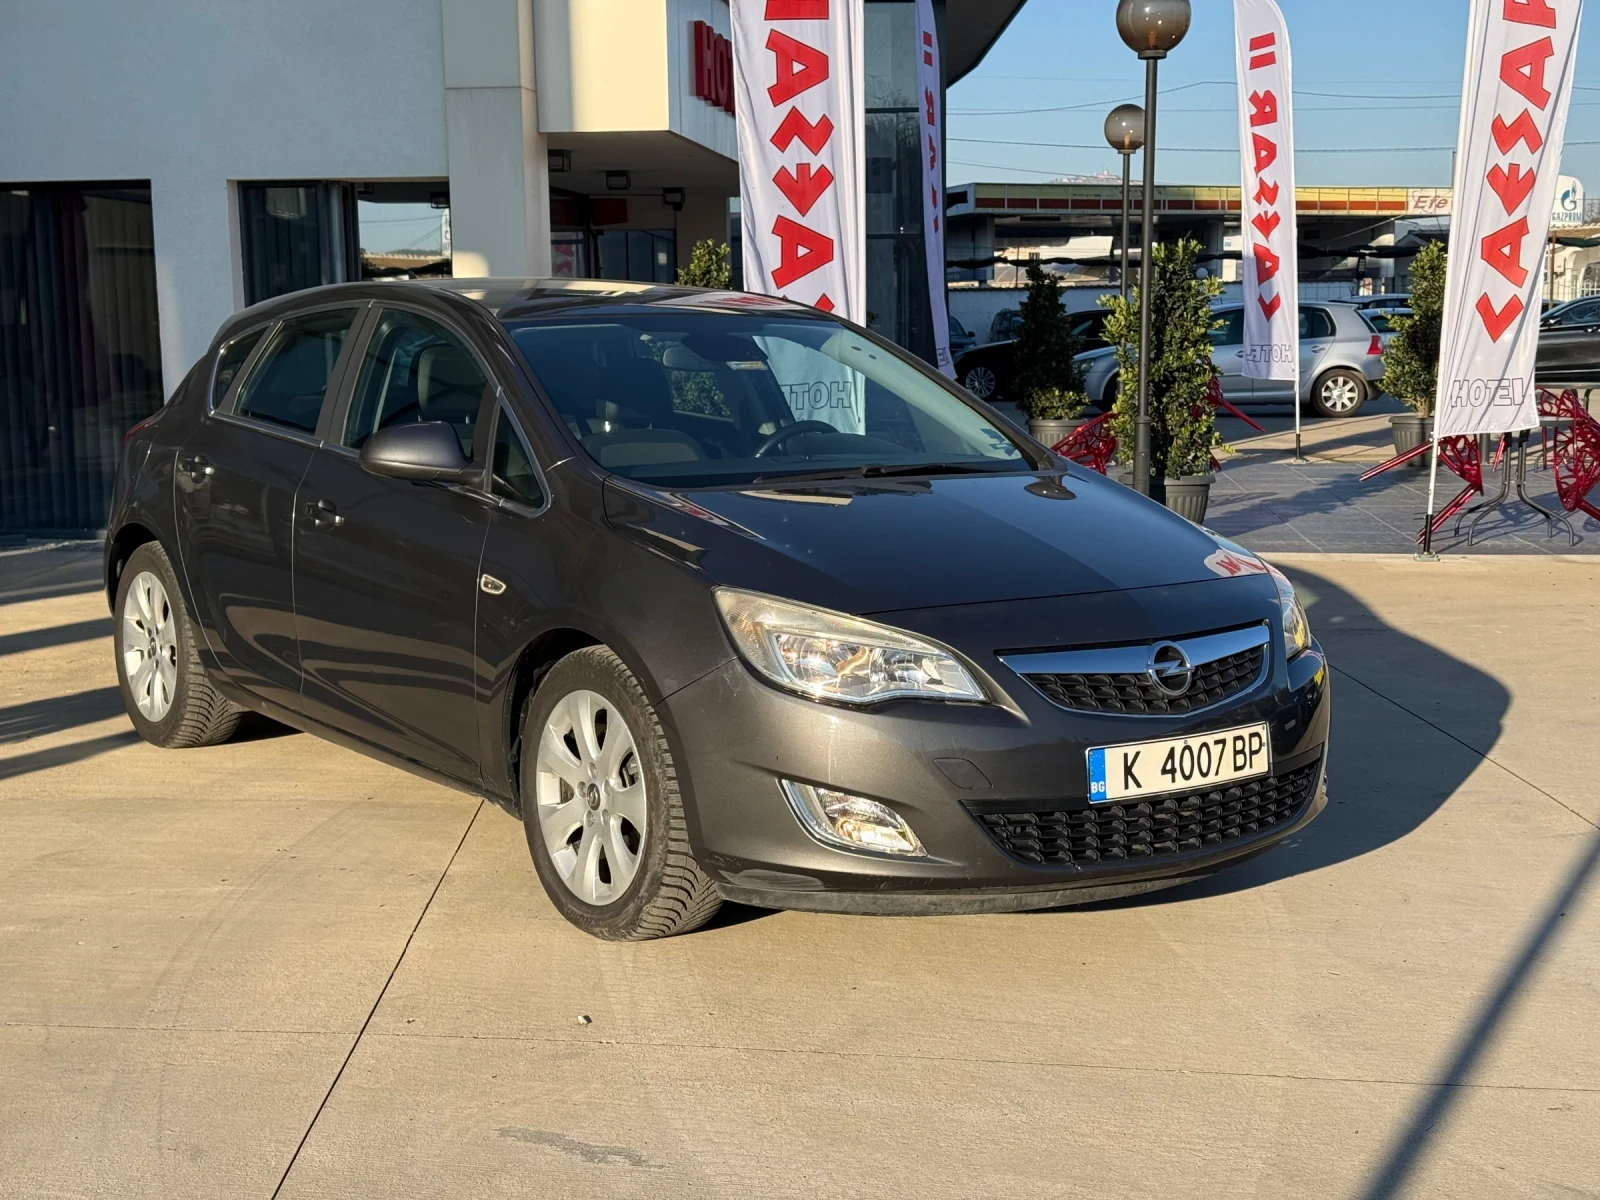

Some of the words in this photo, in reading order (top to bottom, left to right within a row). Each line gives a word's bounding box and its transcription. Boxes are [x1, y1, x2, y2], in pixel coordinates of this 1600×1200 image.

[1552, 212, 1582, 222] GAZPROM
[1123, 751, 1143, 790] K
[1091, 781, 1105, 794] BG
